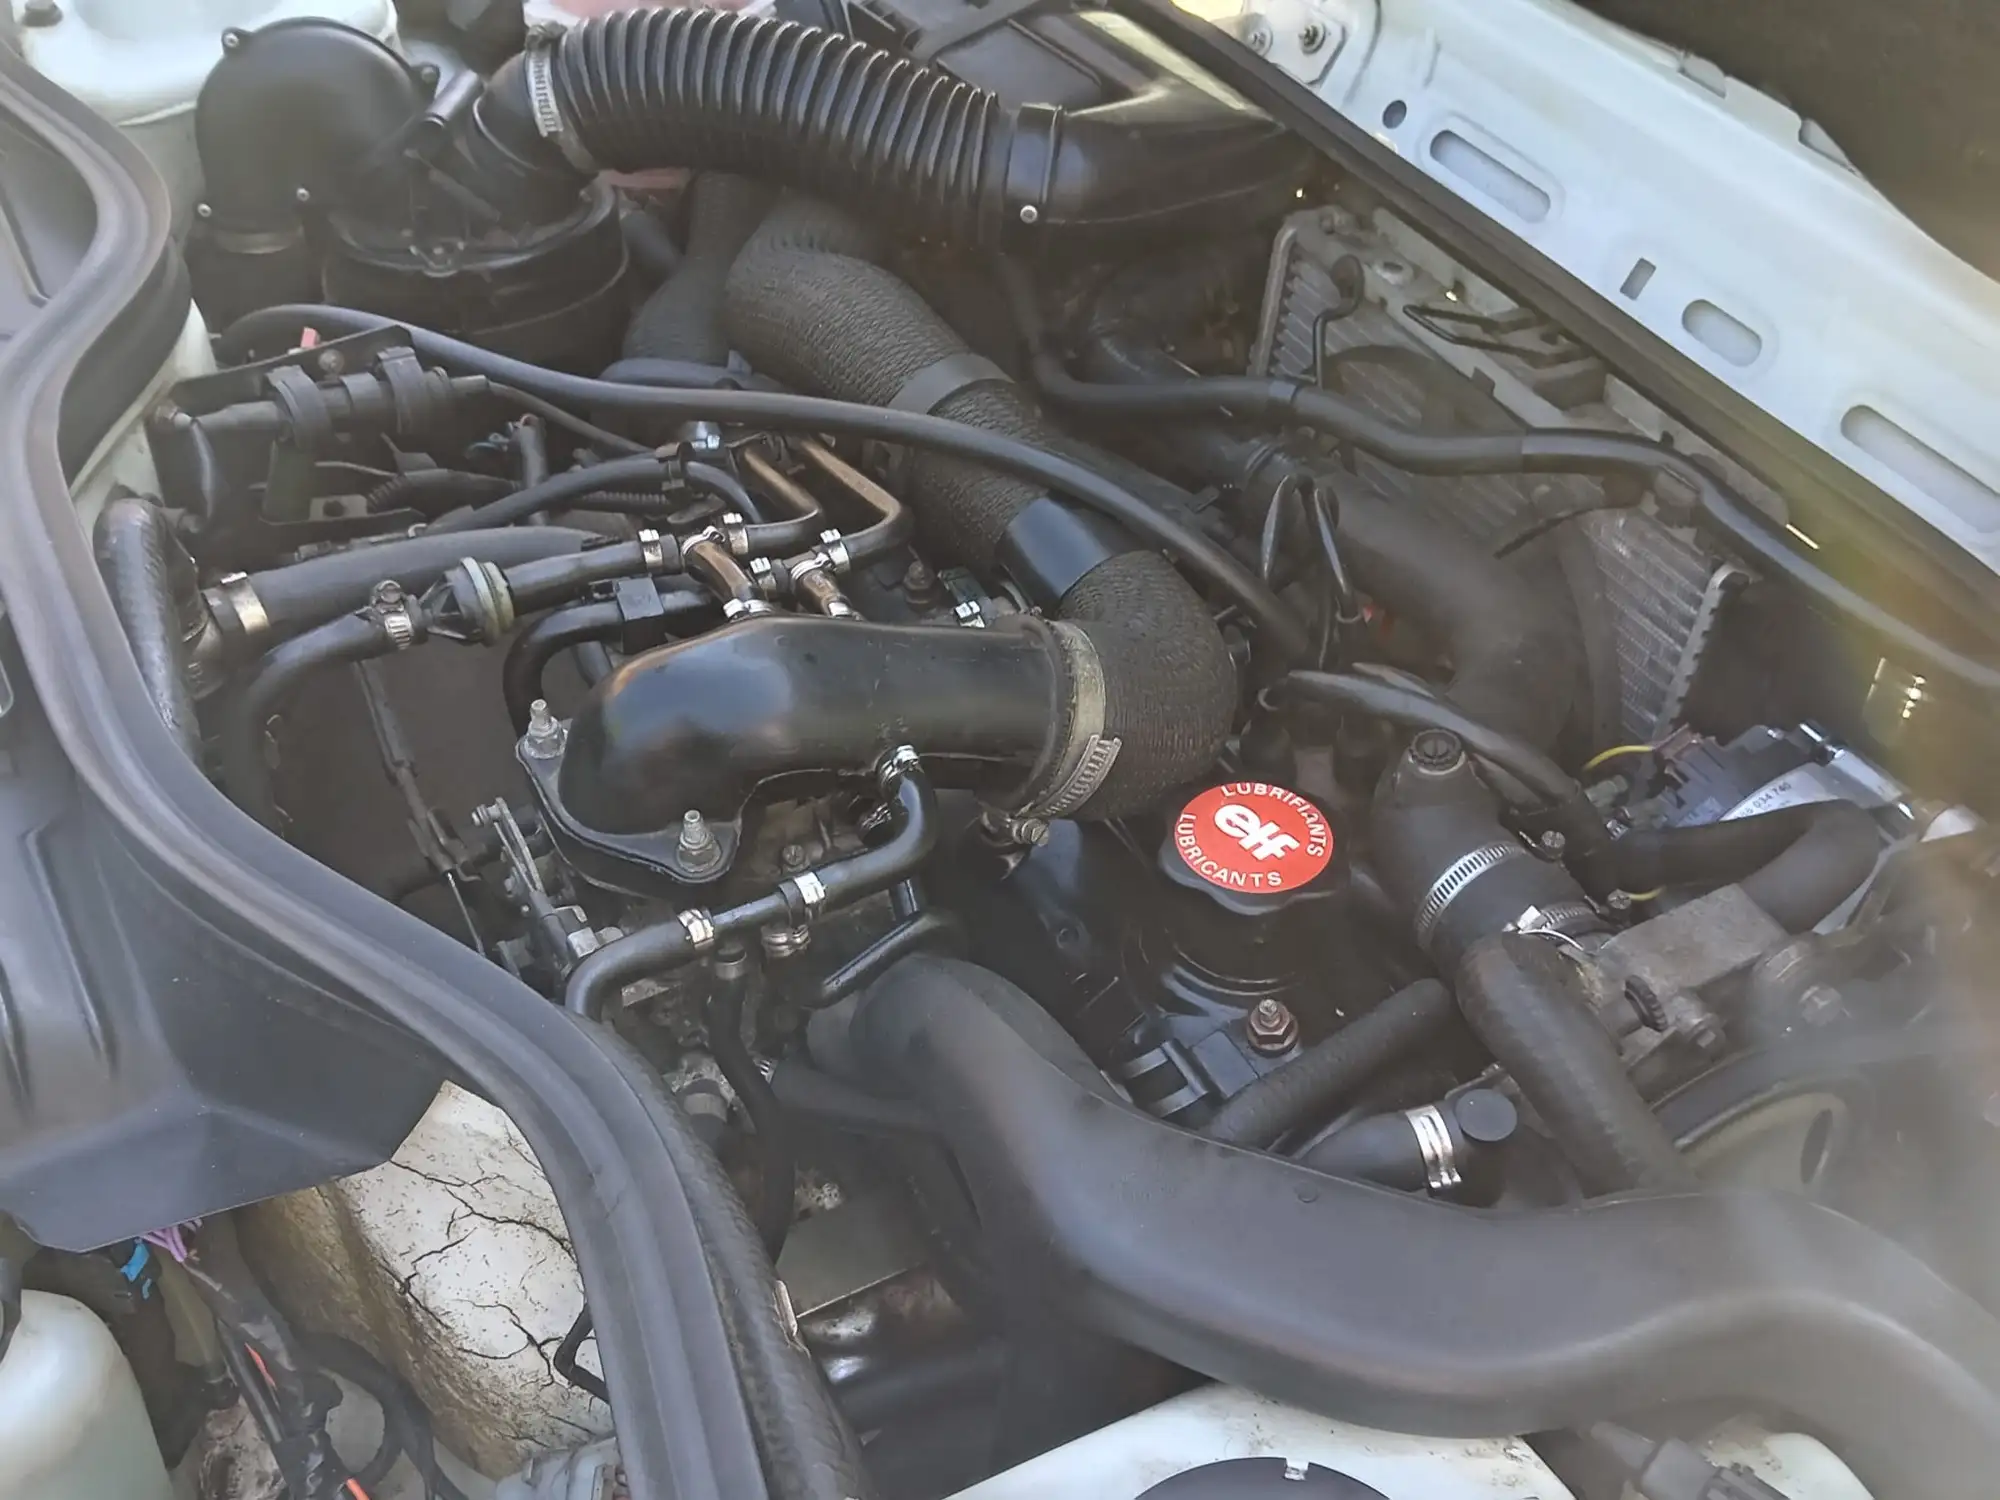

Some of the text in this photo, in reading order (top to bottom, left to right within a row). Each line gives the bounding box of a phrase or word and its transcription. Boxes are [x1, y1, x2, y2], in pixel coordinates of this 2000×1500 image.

[1177, 812, 1282, 887] LUBRICANTS
[1213, 803, 1301, 861] elf
[1221, 782, 1327, 858] LUBRIFIANTS
